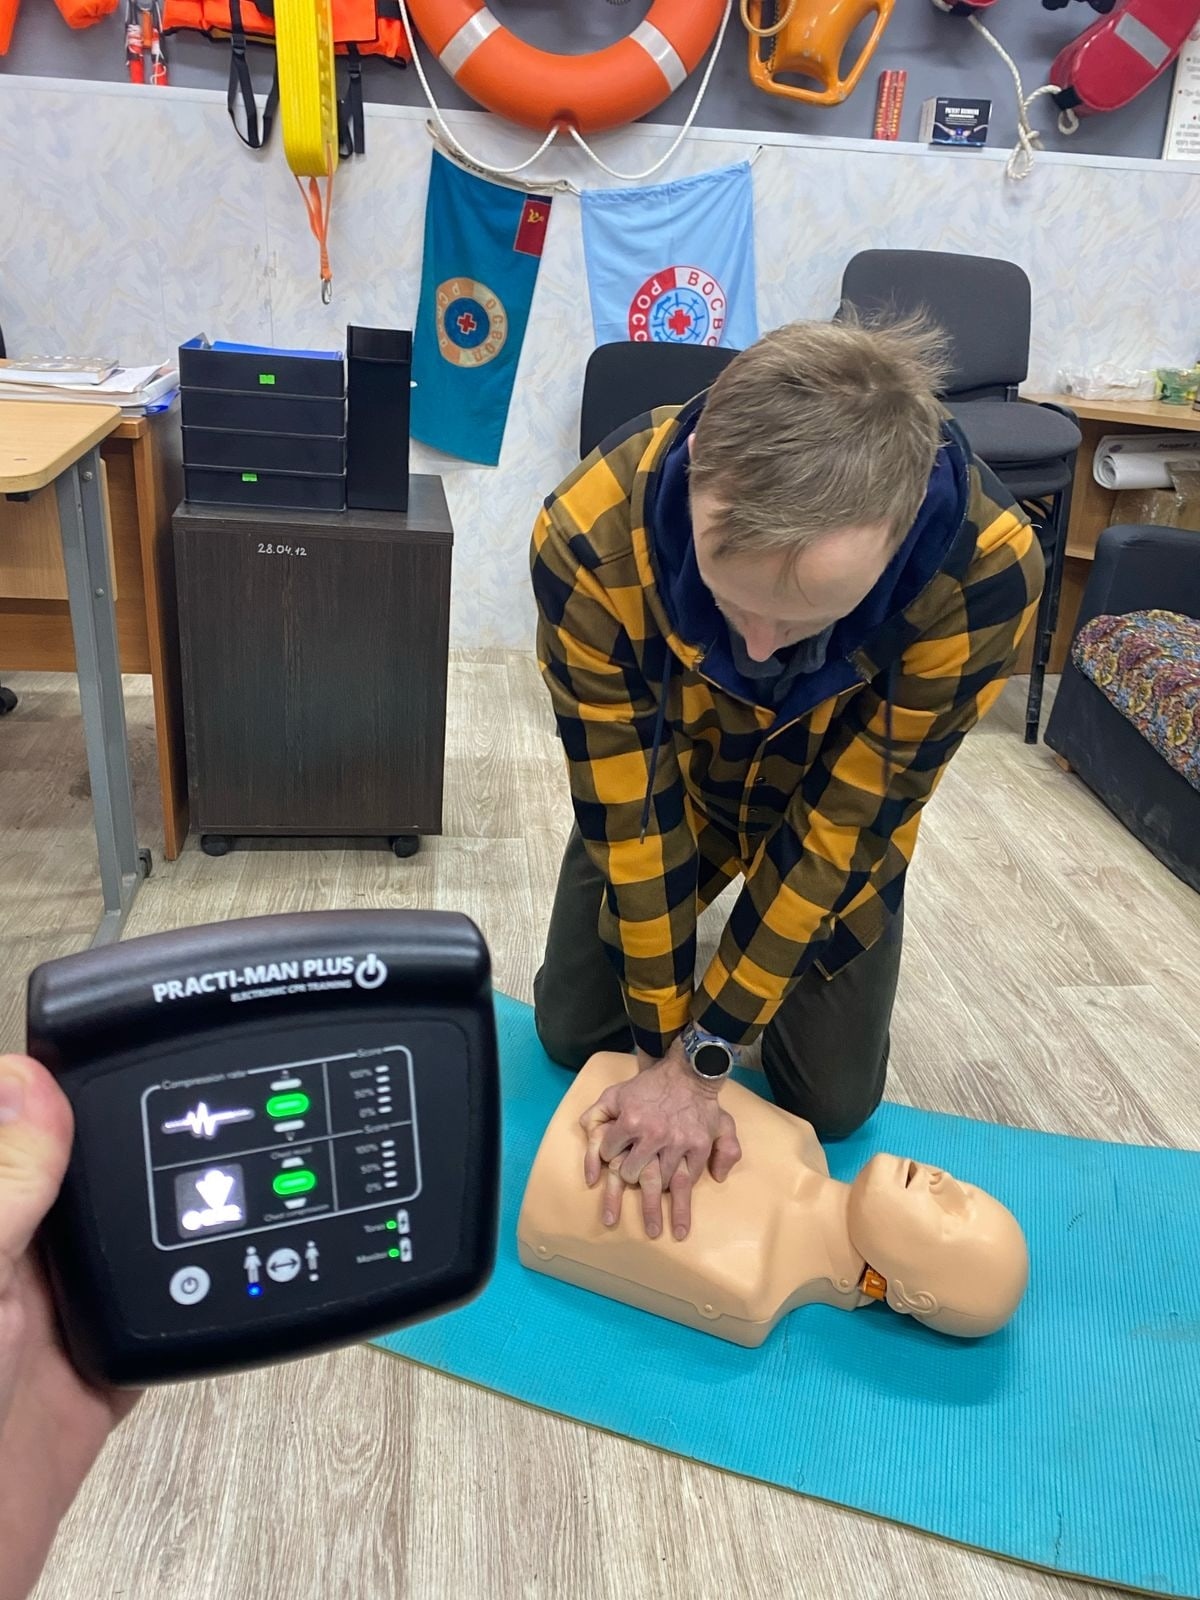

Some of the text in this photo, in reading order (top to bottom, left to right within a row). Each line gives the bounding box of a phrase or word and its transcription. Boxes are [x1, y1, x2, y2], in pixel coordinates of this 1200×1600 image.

[257, 543, 307, 556] 28.04.12
[152, 956, 355, 1003] PRACTI-MAN PLUS
[230, 985, 287, 1003] ELECTRONIC
[307, 979, 353, 992] TRAINING
[356, 1048, 383, 1058] Score
[161, 1073, 225, 1090] Compression
[363, 1123, 390, 1134] Score
